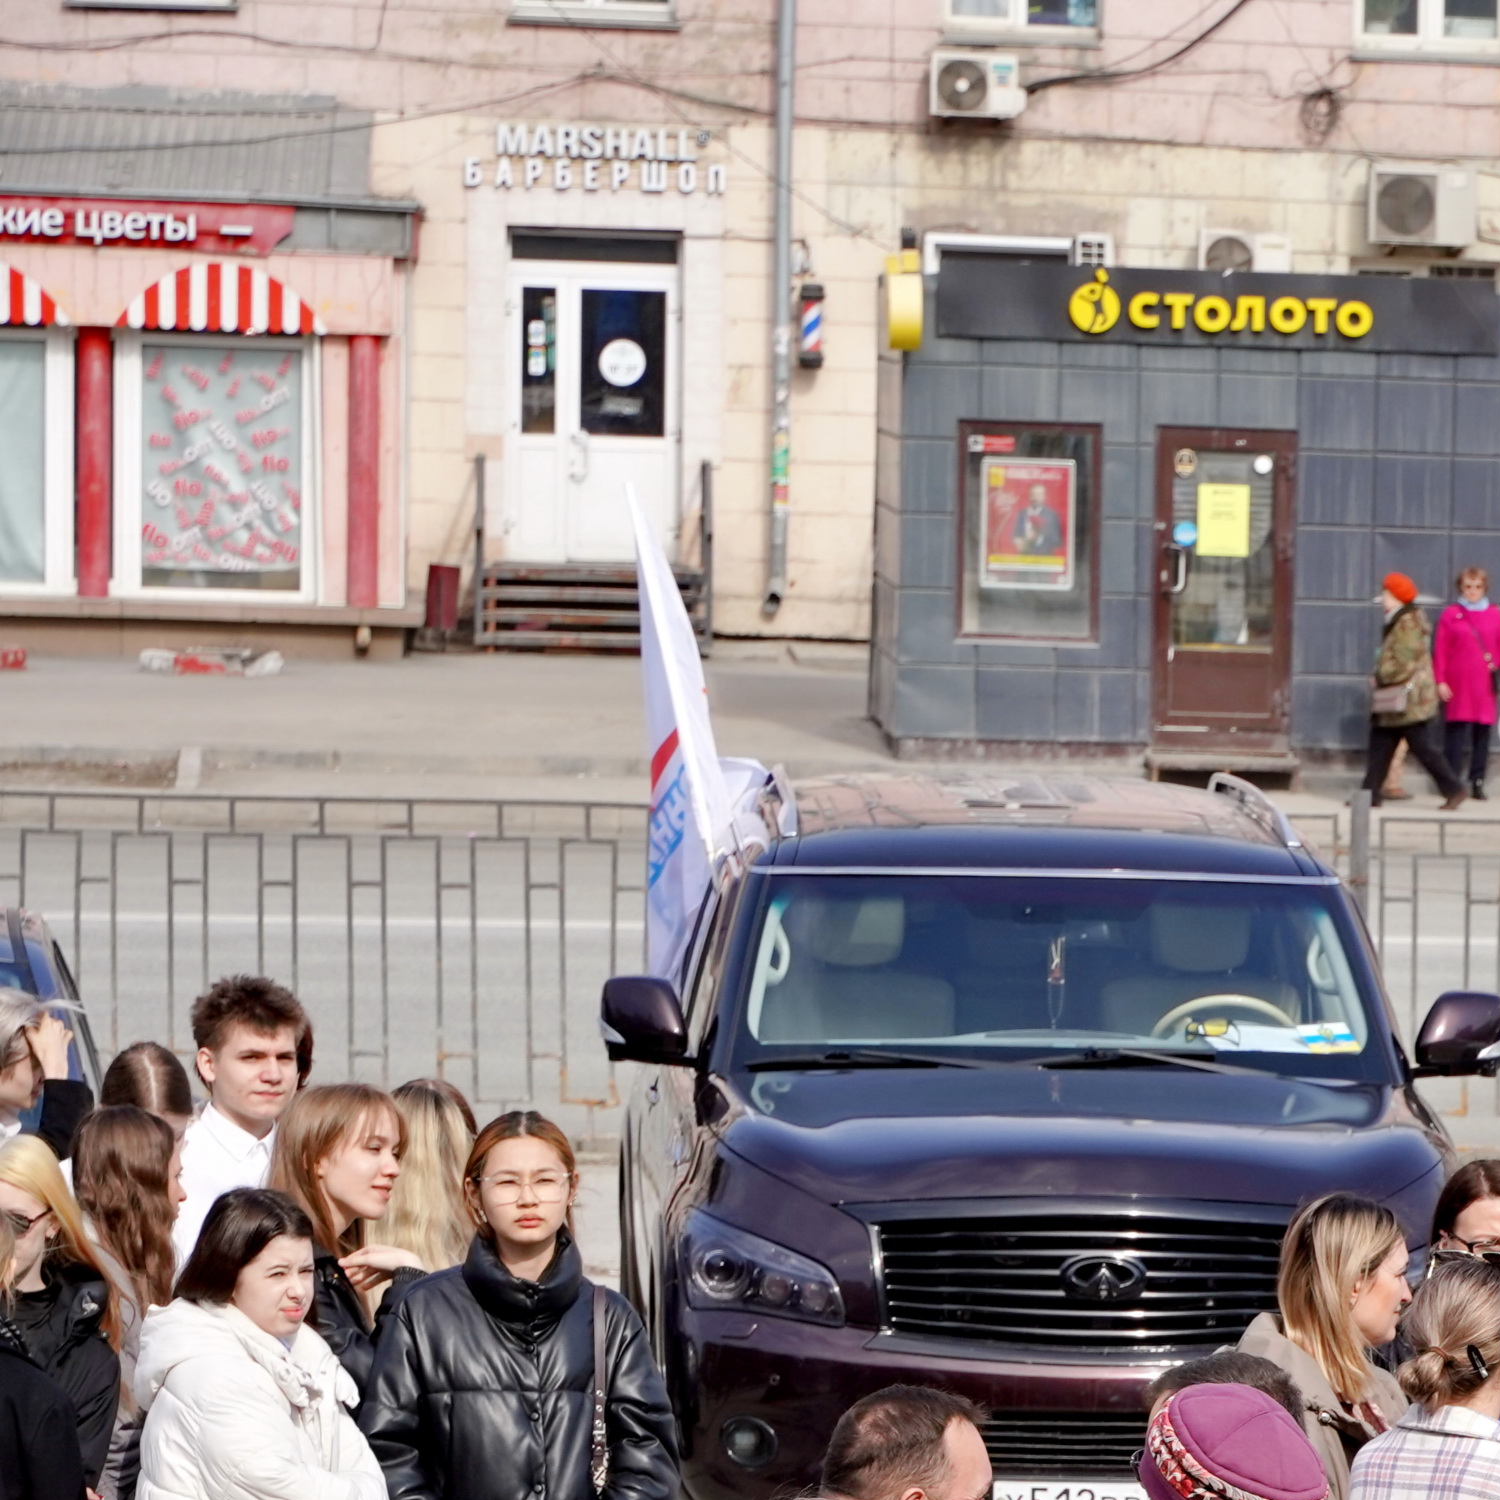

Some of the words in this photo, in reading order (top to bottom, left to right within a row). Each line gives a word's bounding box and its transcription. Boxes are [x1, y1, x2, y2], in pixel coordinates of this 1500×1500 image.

[496, 124, 698, 162] MARSHALL
[464, 156, 726, 194] БАРБЕРШОП
[75, 208, 197, 245] цветы
[1128, 291, 1374, 338] СТОЛОТО
